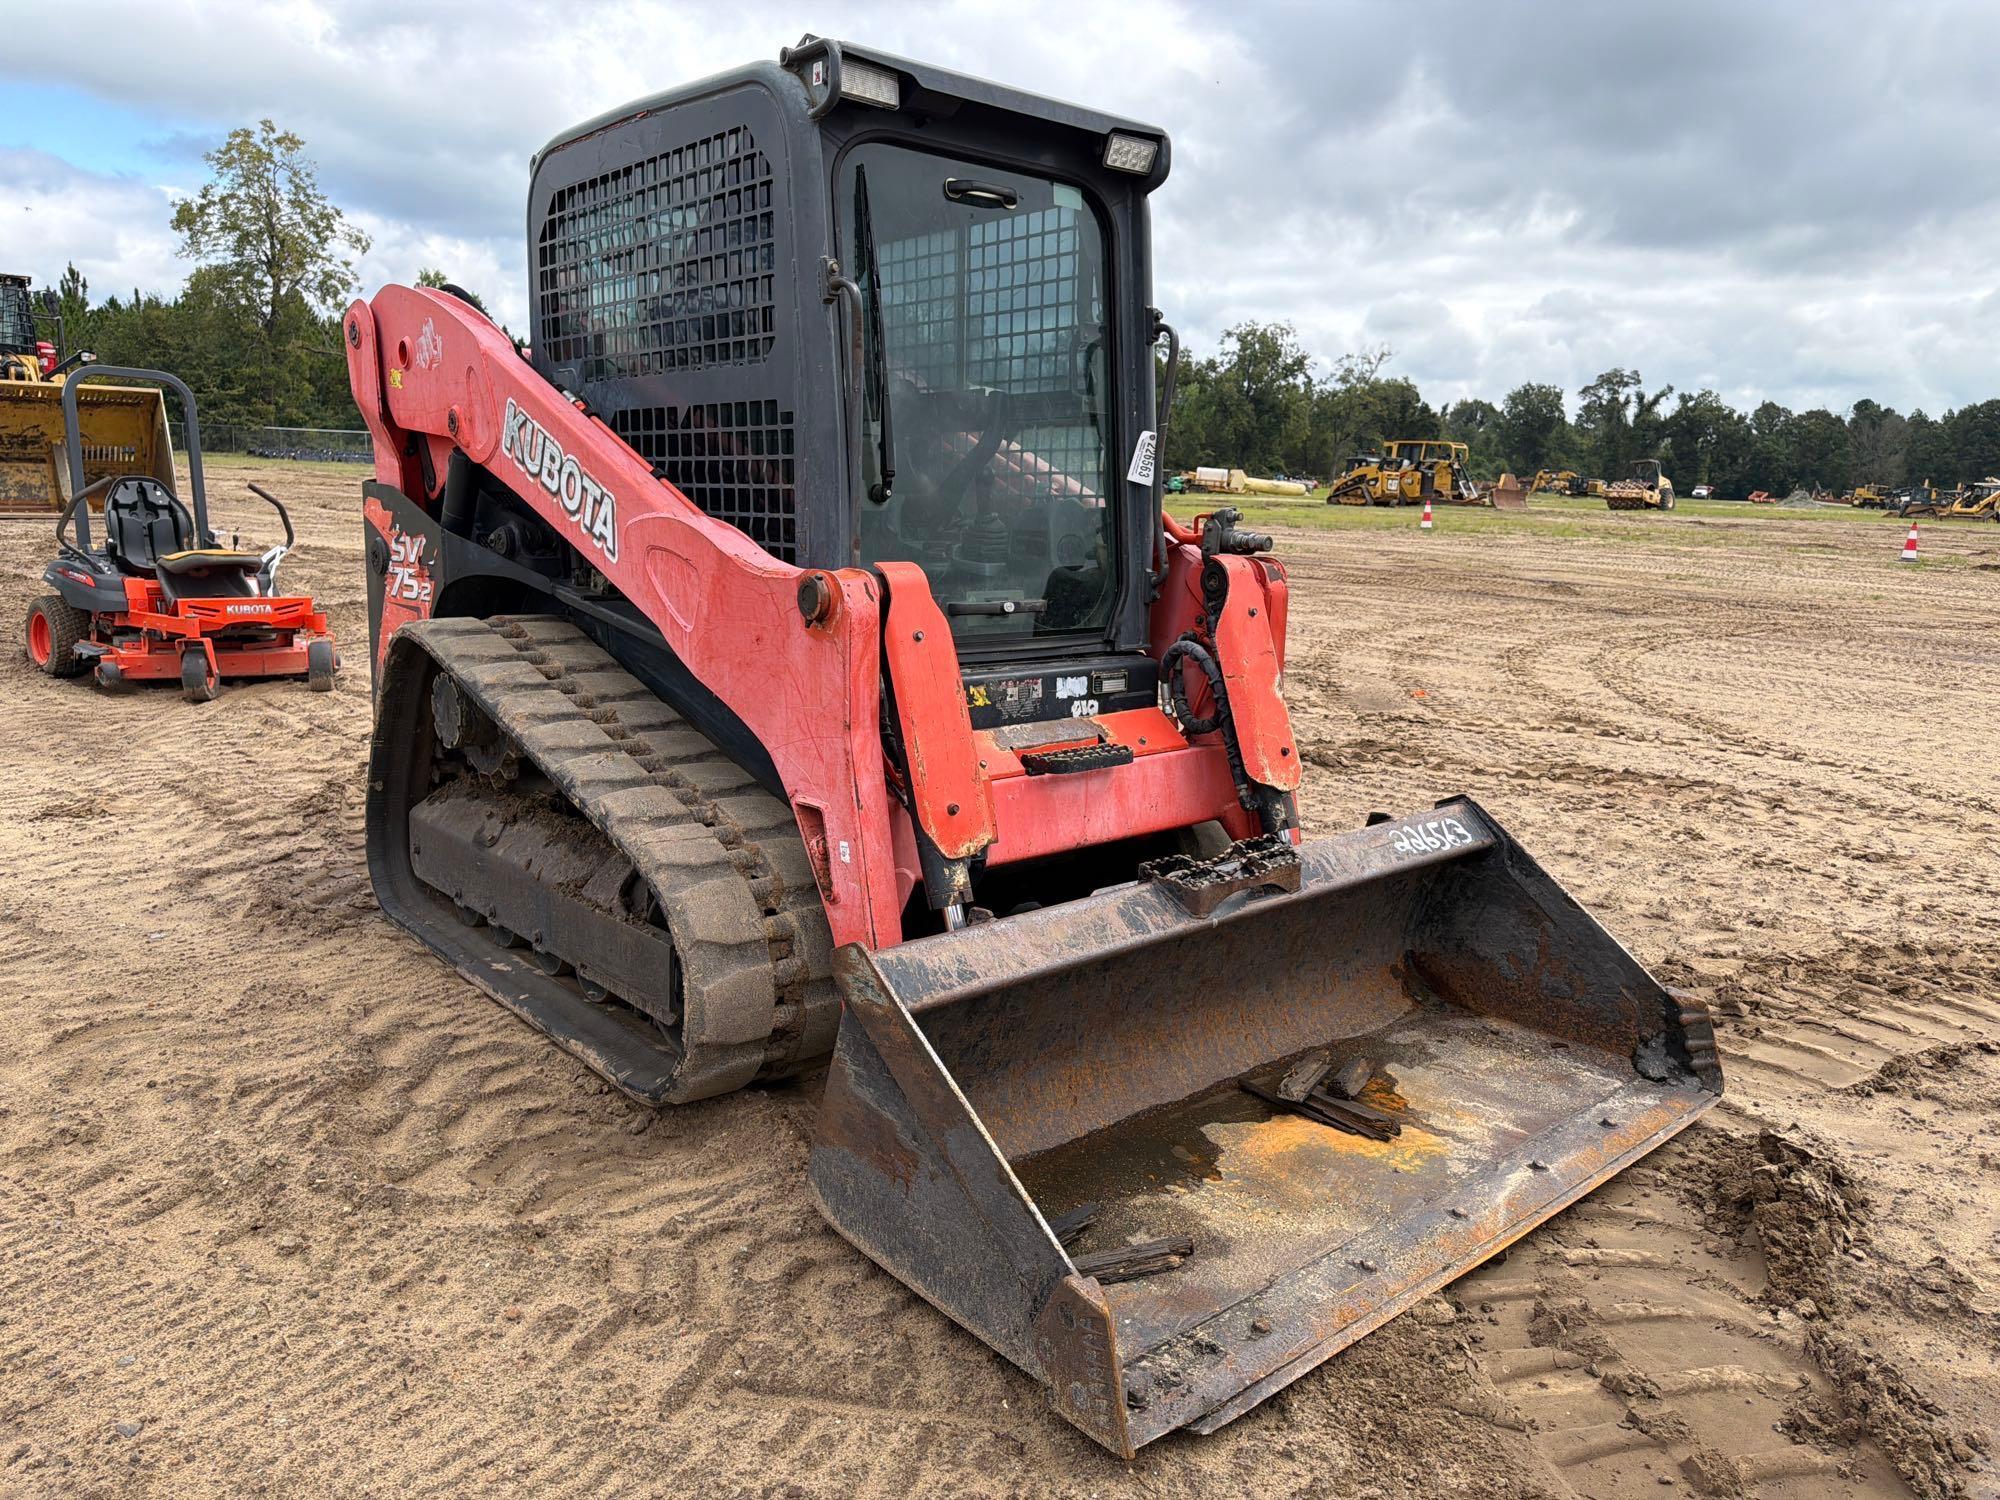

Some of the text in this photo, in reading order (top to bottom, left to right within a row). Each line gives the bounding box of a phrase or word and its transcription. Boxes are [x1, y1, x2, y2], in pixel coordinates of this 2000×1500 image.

[1138, 442, 1156, 478] 226563
[503, 399, 618, 562] KUBOTA
[391, 535, 426, 564] SV
[226, 604, 272, 614] KUBOTA
[1388, 818, 1472, 853] 226563
